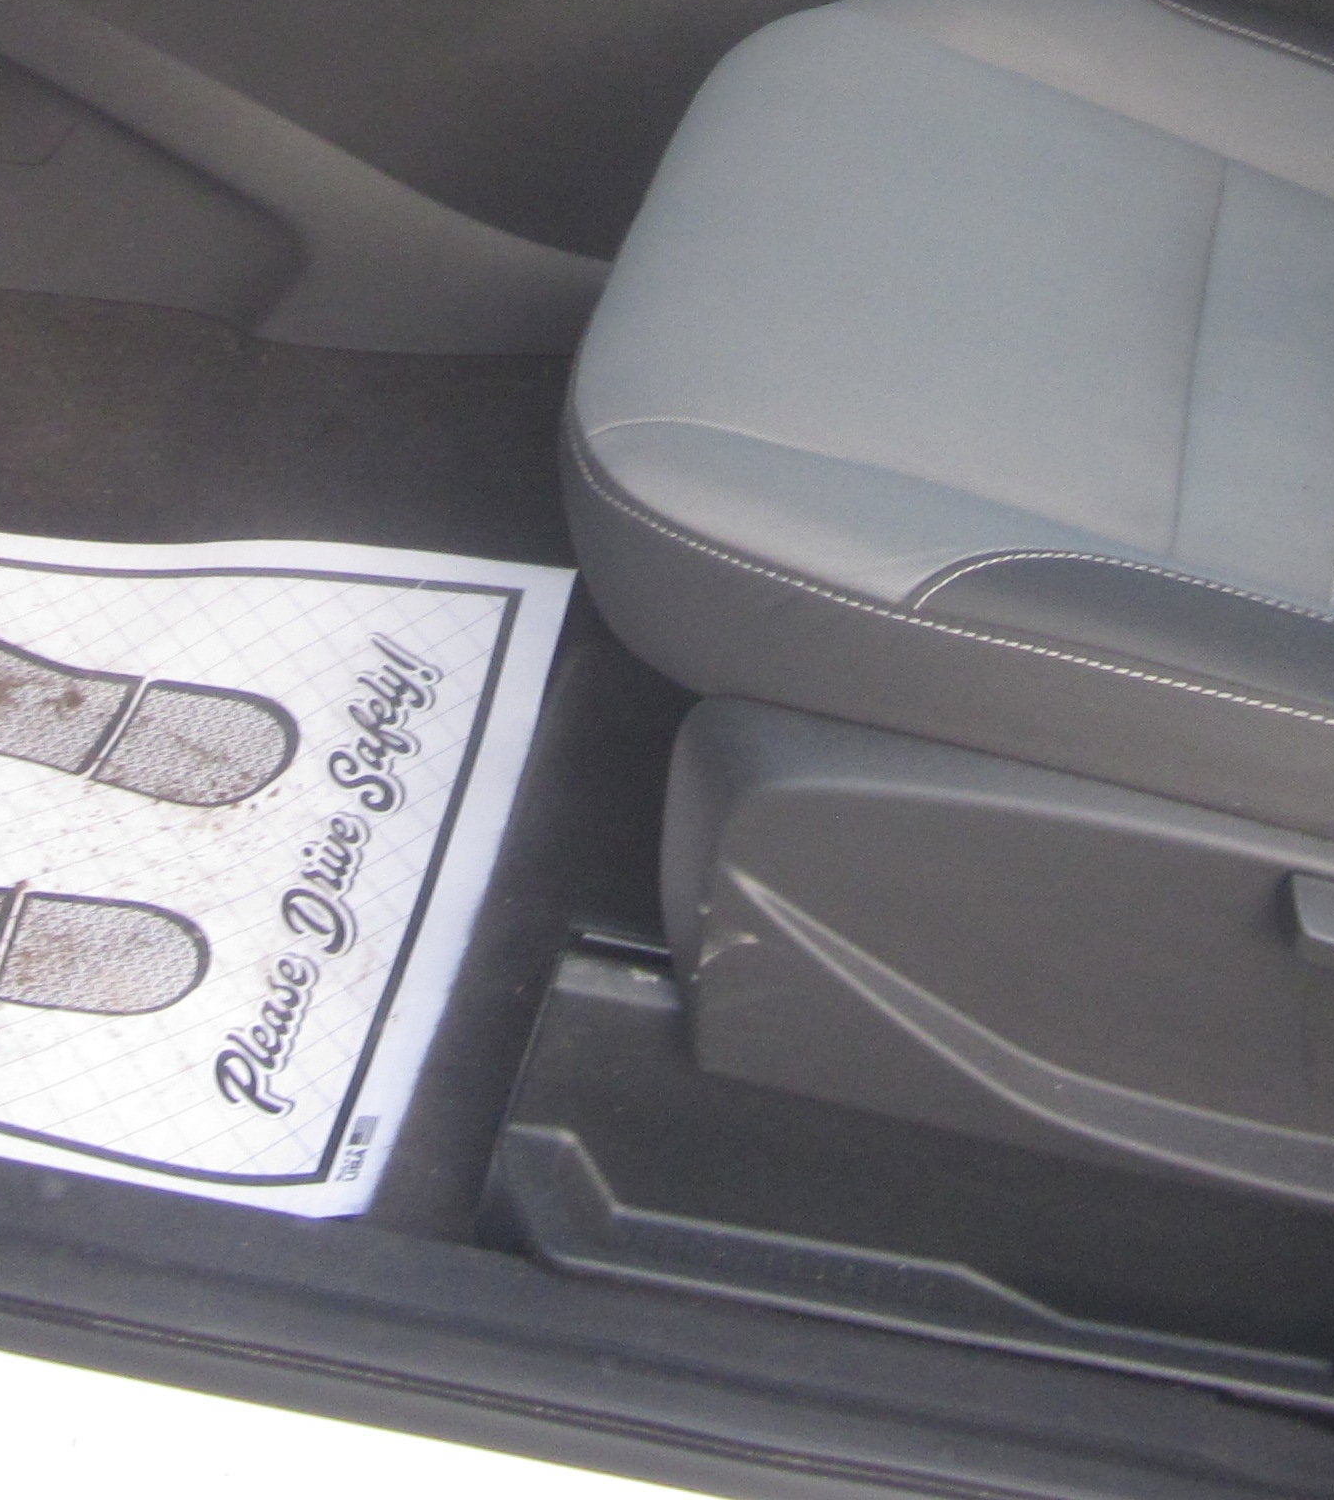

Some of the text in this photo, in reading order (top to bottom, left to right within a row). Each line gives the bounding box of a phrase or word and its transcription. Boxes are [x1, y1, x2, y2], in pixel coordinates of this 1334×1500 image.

[216, 633, 435, 1115] Please Drive Safely!
